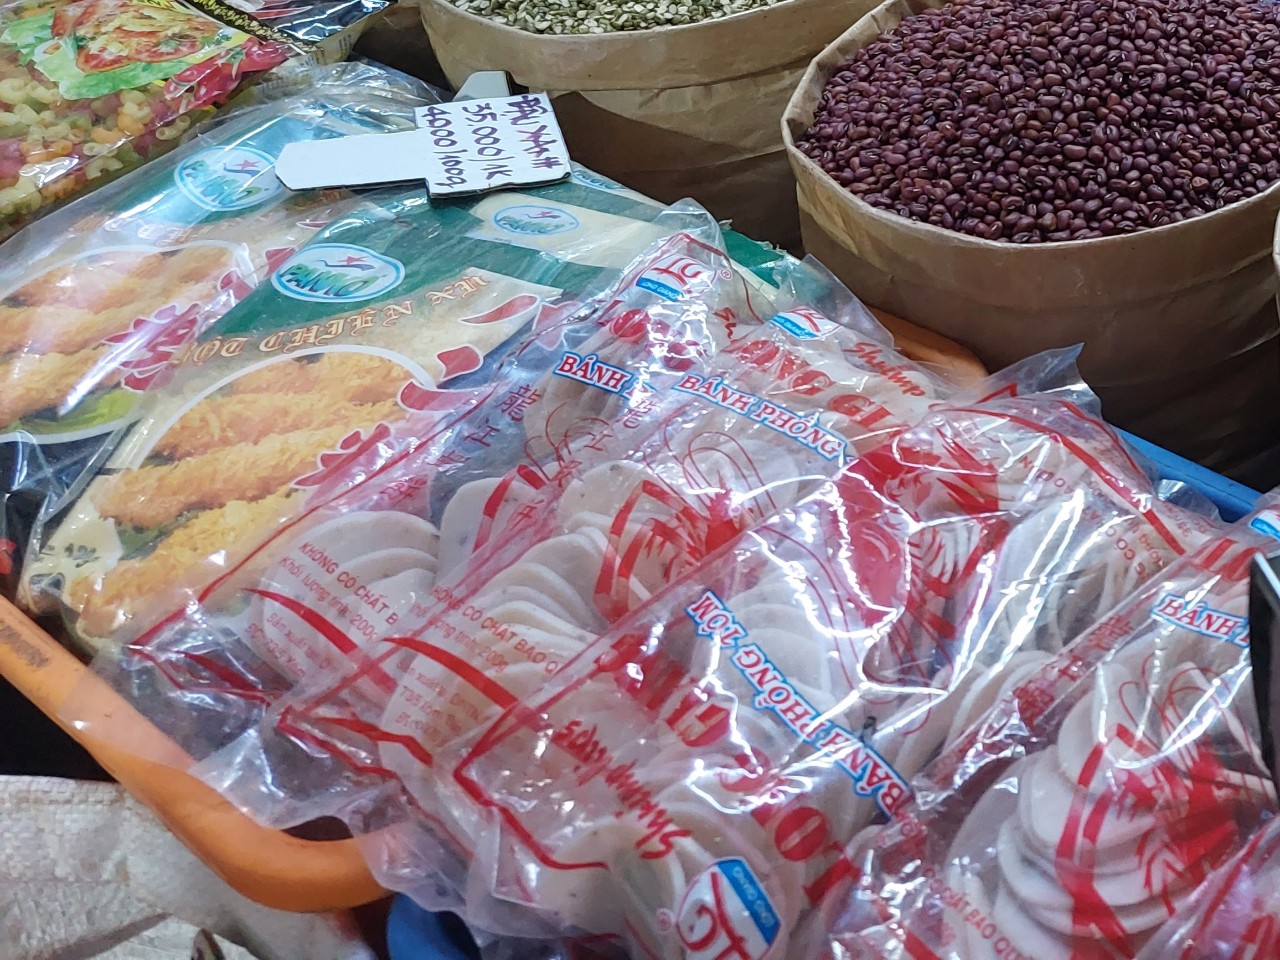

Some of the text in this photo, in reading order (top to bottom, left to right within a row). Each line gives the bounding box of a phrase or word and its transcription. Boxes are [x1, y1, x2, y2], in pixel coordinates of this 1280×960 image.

[556, 354, 628, 390] BÁNH
[677, 374, 755, 415] BÁNH
[1156, 594, 1238, 638] BÁNH
